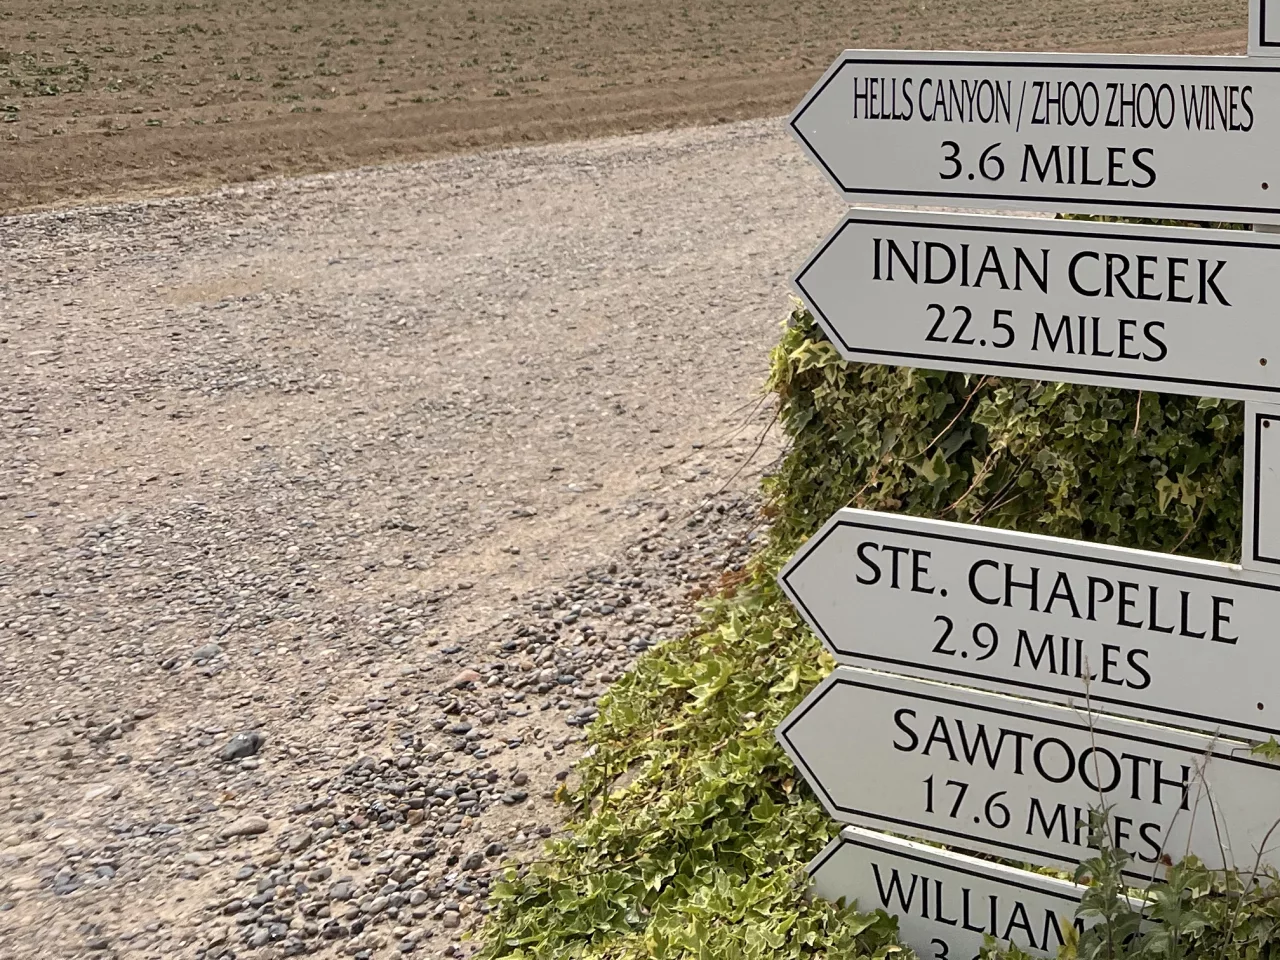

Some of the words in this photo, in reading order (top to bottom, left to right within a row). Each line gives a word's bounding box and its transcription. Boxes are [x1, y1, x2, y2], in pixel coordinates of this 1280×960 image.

[853, 76, 914, 123] HELLS
[918, 77, 1012, 126] CANYON
[1015, 80, 1027, 133] /
[1030, 80, 1100, 128] ZHOO
[1104, 82, 1176, 130] ZHOO
[1180, 83, 1254, 133] WINES
[938, 140, 1006, 182] 3.6
[1019, 143, 1157, 189] MILES
[872, 237, 1051, 295] INDIAN
[1067, 250, 1233, 307] CREEK
[924, 303, 1016, 349] 22.5
[1030, 311, 1168, 363] MILES
[855, 541, 948, 597] STE.
[967, 558, 1239, 646] CHAPELLE
[931, 614, 999, 662] 2.9
[1012, 628, 1152, 691] MILES
[892, 707, 1192, 811] SAWTOOTH
[922, 773, 1011, 830] 17.6
[1025, 796, 1163, 864] MILES
[870, 862, 1196, 960] WILLIAM
